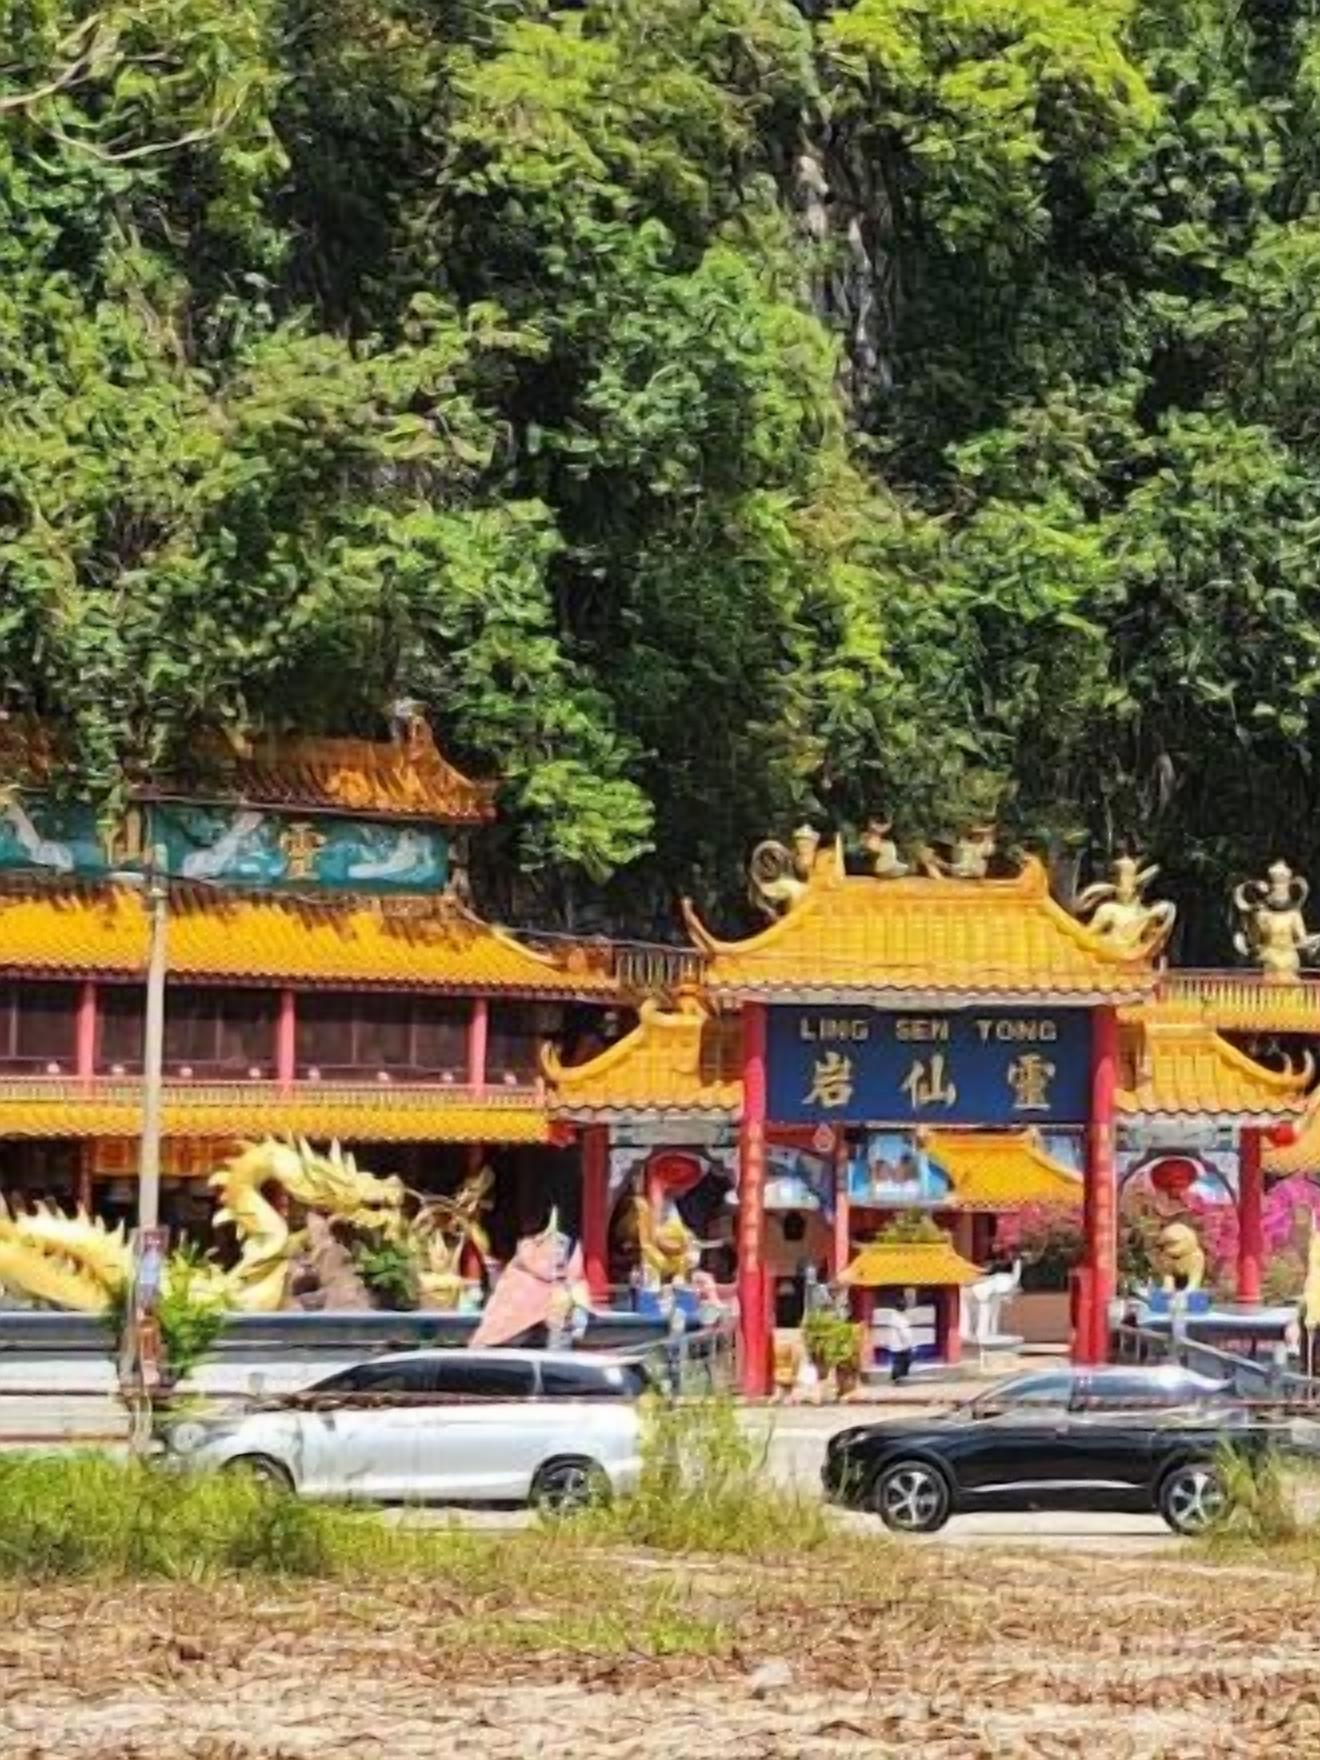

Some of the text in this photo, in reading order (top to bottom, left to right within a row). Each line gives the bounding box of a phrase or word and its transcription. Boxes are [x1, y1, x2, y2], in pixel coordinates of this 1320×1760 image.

[801, 1018, 1058, 1041] LING SEN TONG
